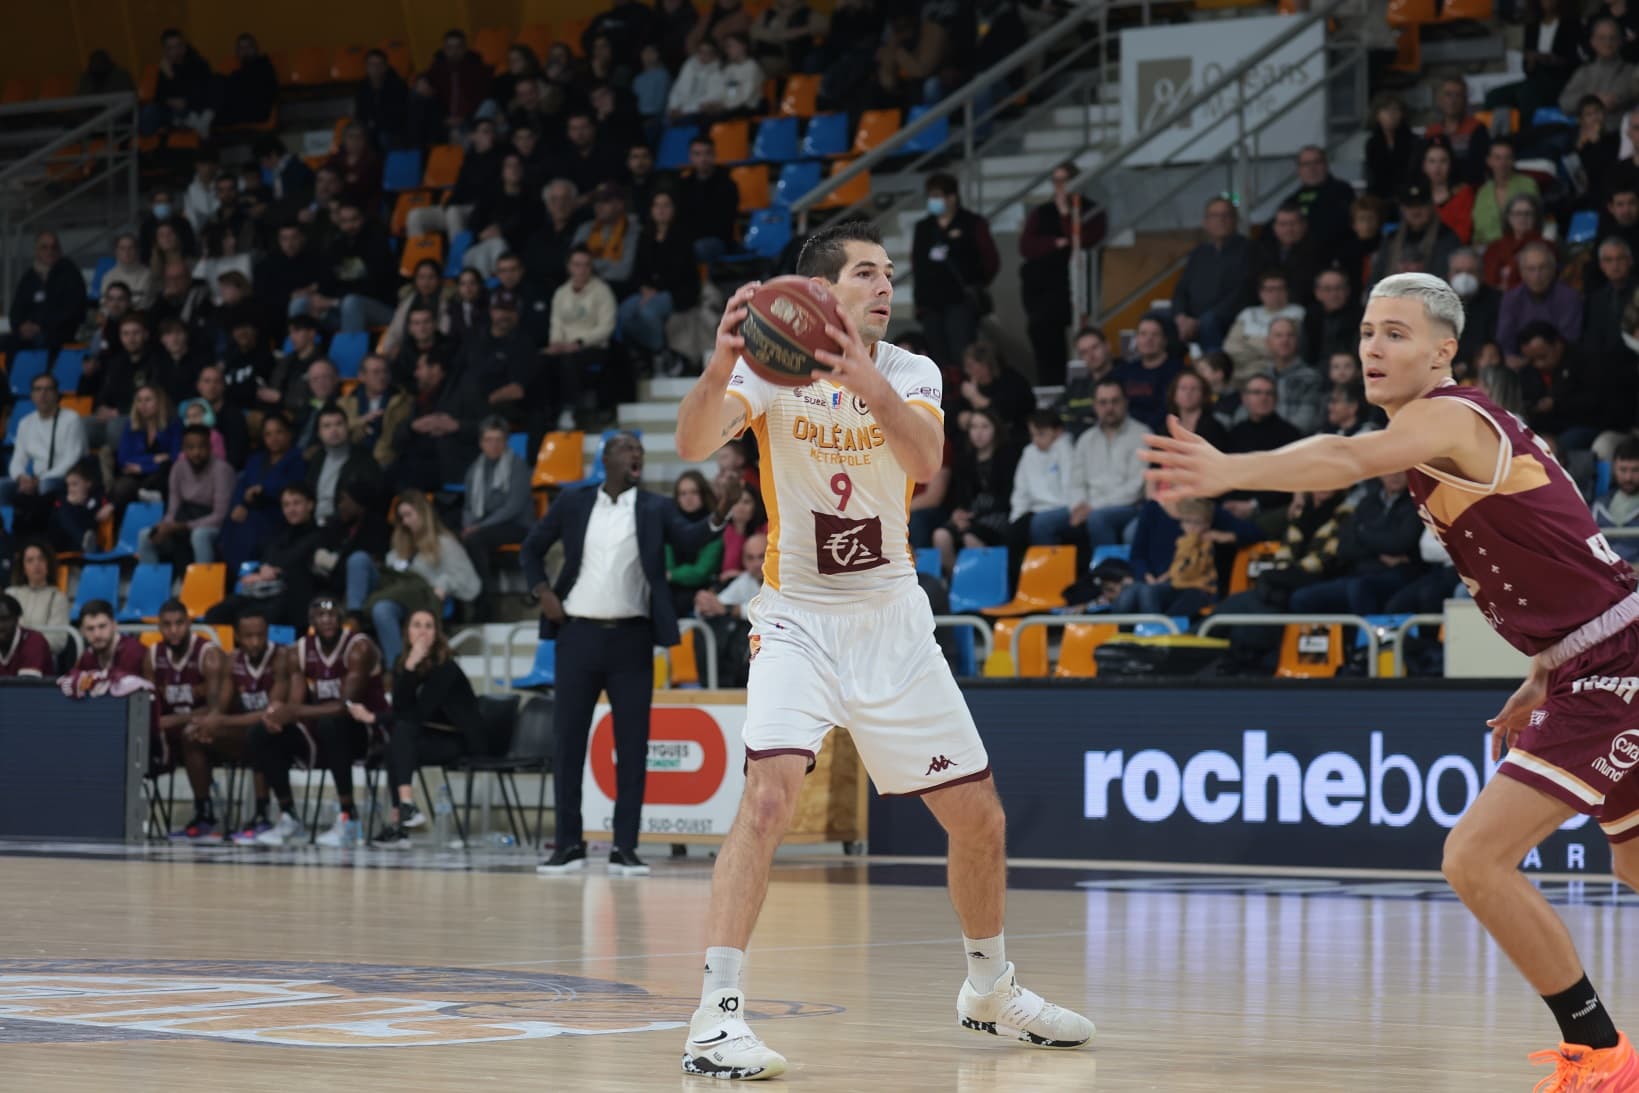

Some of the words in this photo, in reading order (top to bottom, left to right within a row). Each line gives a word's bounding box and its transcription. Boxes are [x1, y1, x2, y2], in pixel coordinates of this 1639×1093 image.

[810, 447, 872, 466] METRPOLE
[830, 472, 853, 512] 9
[1084, 730, 1589, 829] rochebo
